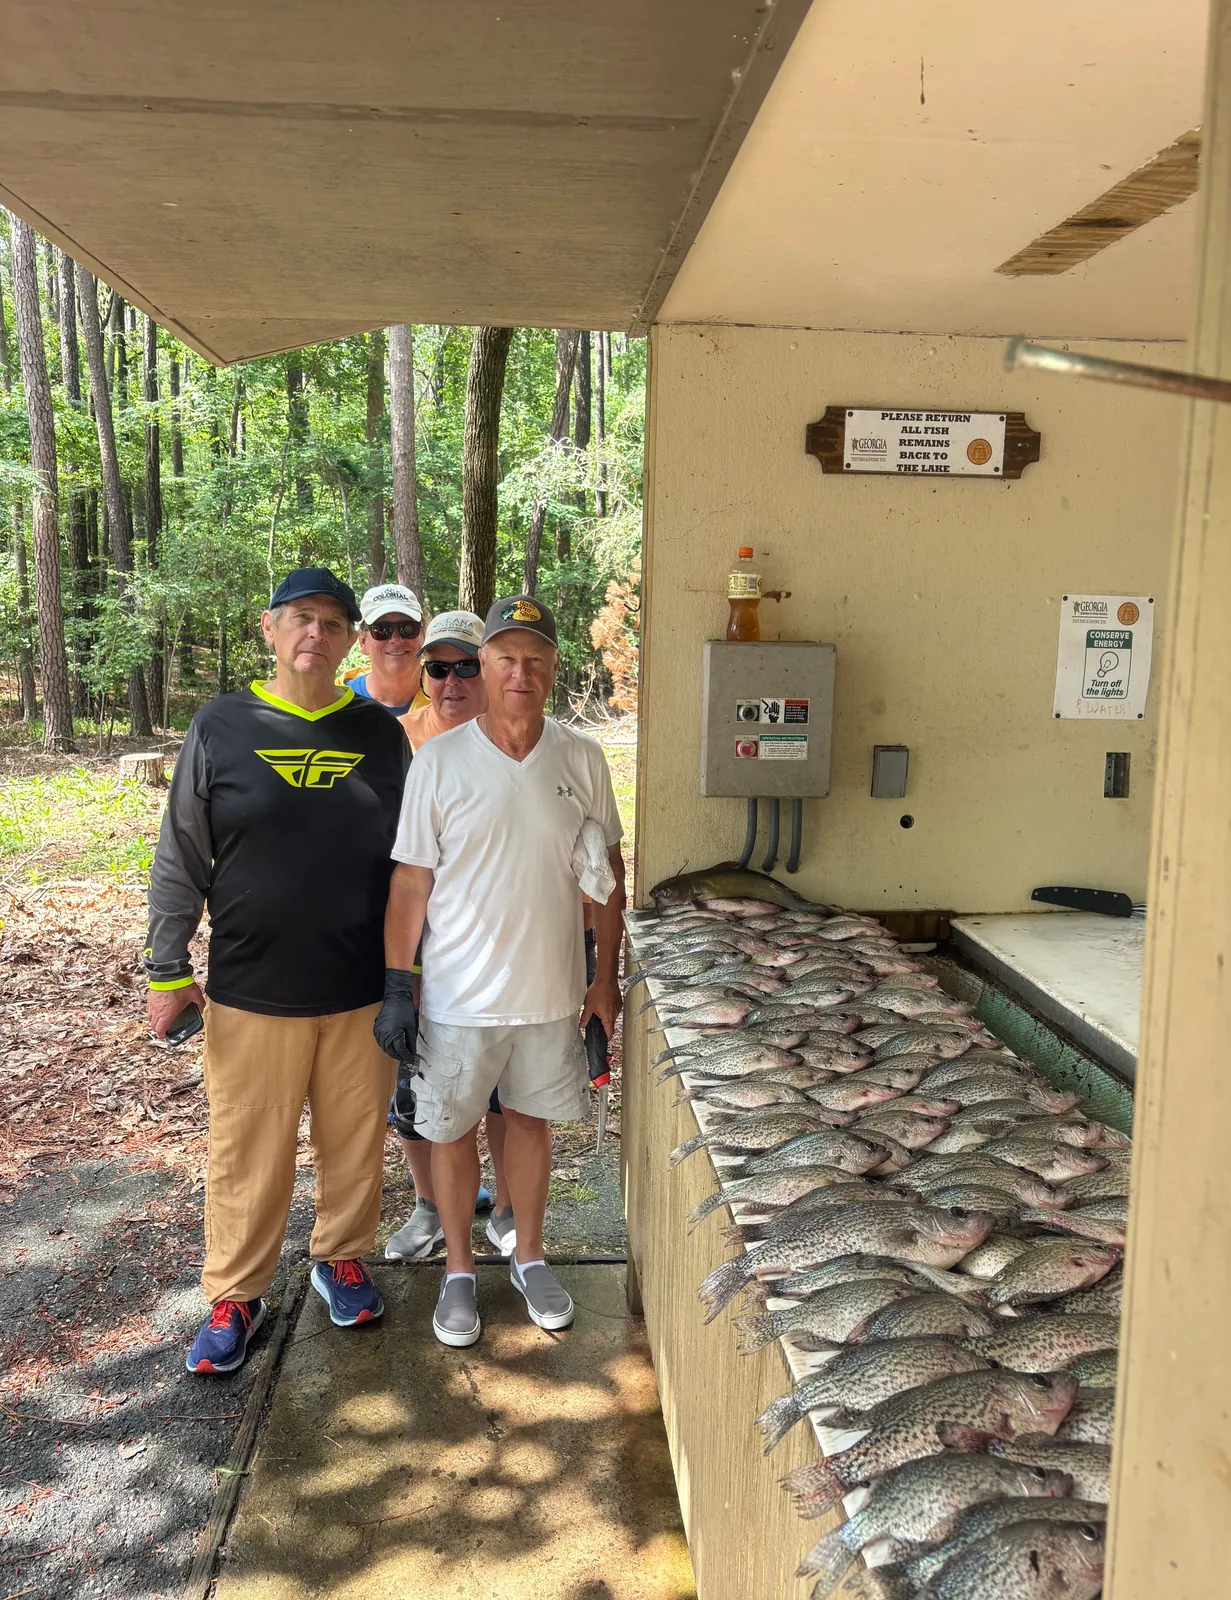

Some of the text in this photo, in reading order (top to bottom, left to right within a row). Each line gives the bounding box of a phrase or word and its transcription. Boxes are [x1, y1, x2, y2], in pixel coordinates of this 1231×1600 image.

[881, 412, 971, 423] PLEASE RETURN
[901, 426, 950, 435] ALL FISH
[859, 438, 887, 449] GEORGIA
[899, 438, 950, 448] REMAINS
[899, 452, 948, 460] BACK TO
[896, 464, 950, 473] THE LAKE
[373, 592, 408, 601] COLONIAL
[1080, 601, 1108, 612] GEORGIA
[1090, 631, 1130, 640] CONSERVE
[1094, 640, 1124, 648] ENERGY
[1091, 679, 1122, 688] Turn off
[1086, 688, 1124, 697] the lights
